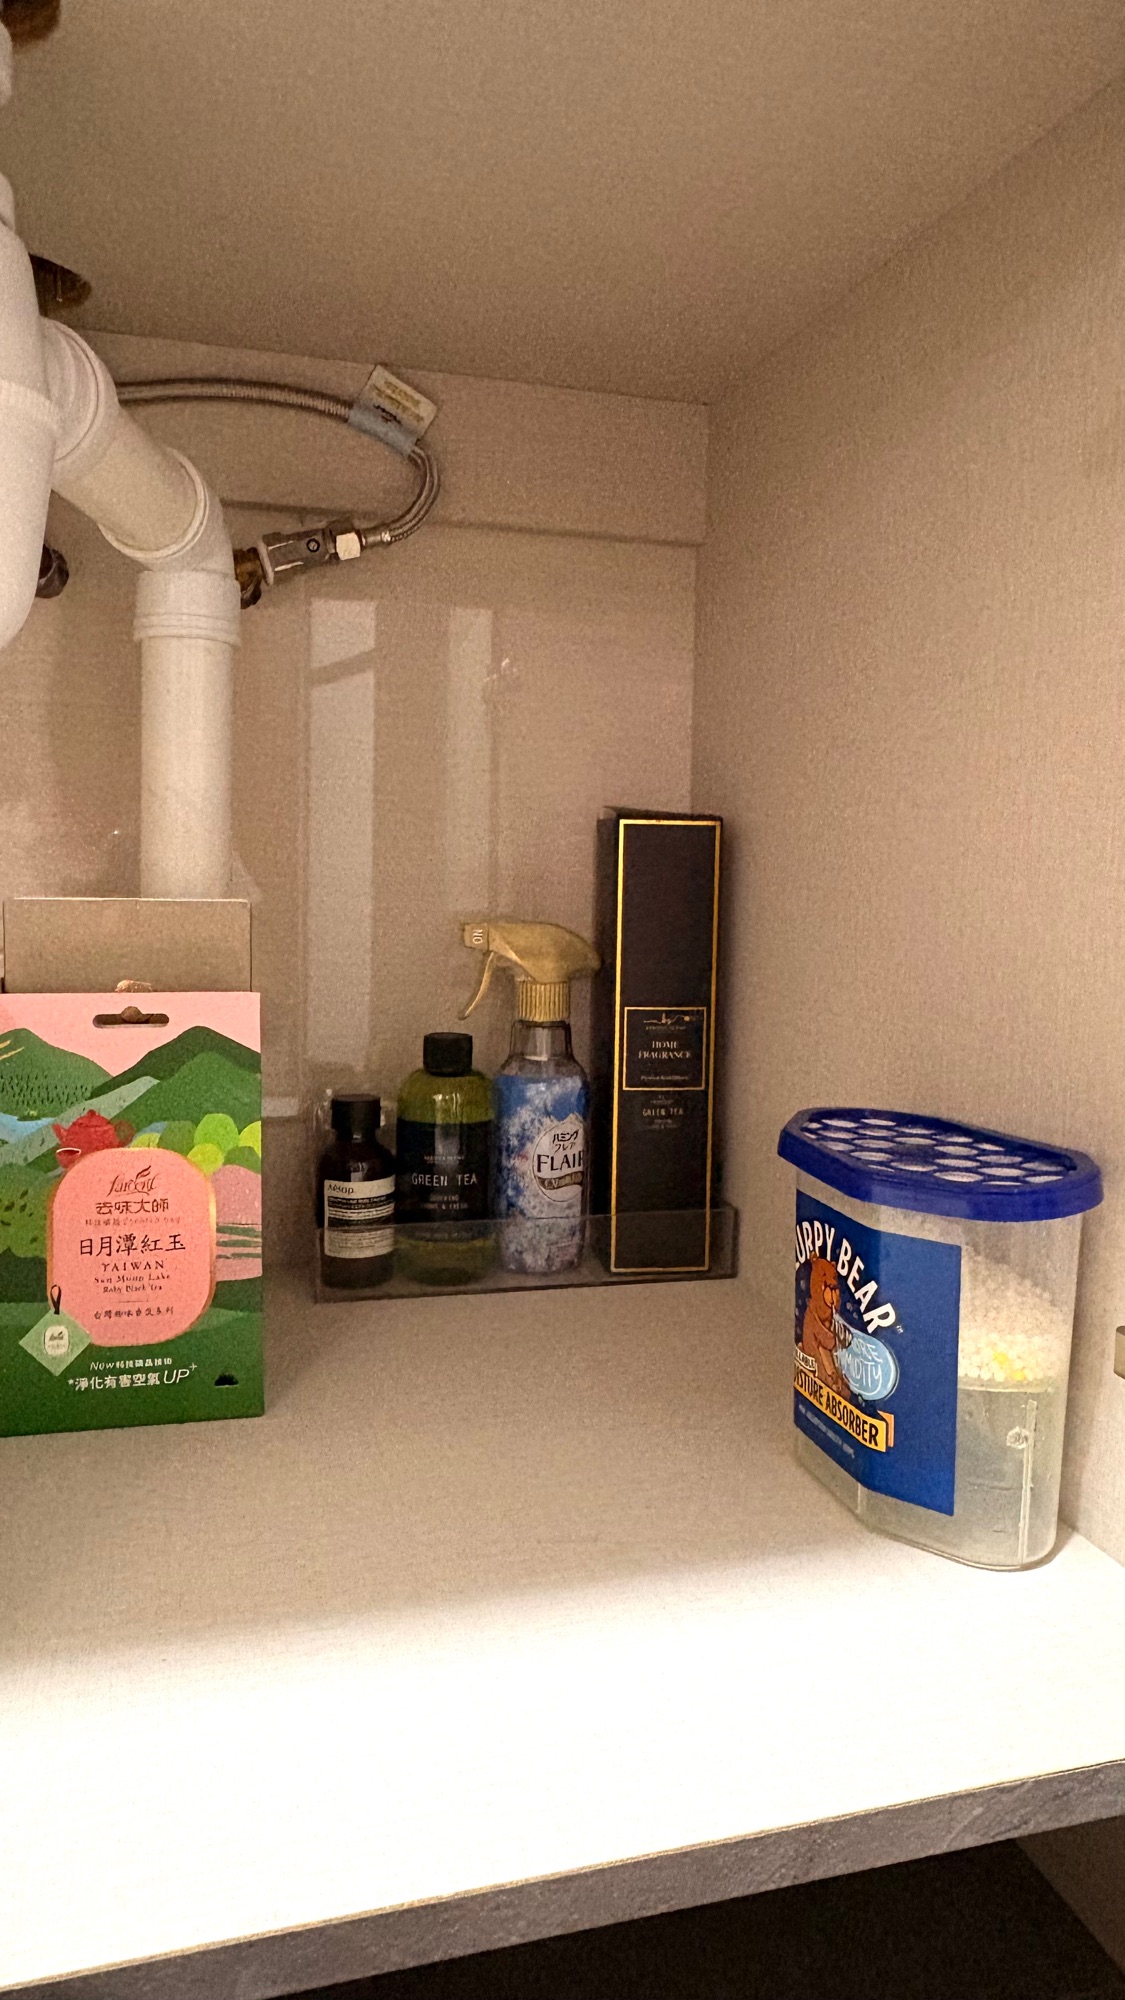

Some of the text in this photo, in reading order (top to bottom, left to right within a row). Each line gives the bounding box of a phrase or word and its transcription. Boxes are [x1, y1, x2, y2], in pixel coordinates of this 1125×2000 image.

[652, 1041, 677, 1049] HOME
[638, 1050, 691, 1059] FRAGRANCE
[411, 1172, 478, 1187] GREEN TEA
[80, 1232, 186, 1257] 日月潭紅玉
[102, 1260, 164, 1272] TAIWAN
[837, 1238, 896, 1334] BEAR
[825, 1391, 879, 1447] ABSORBER
